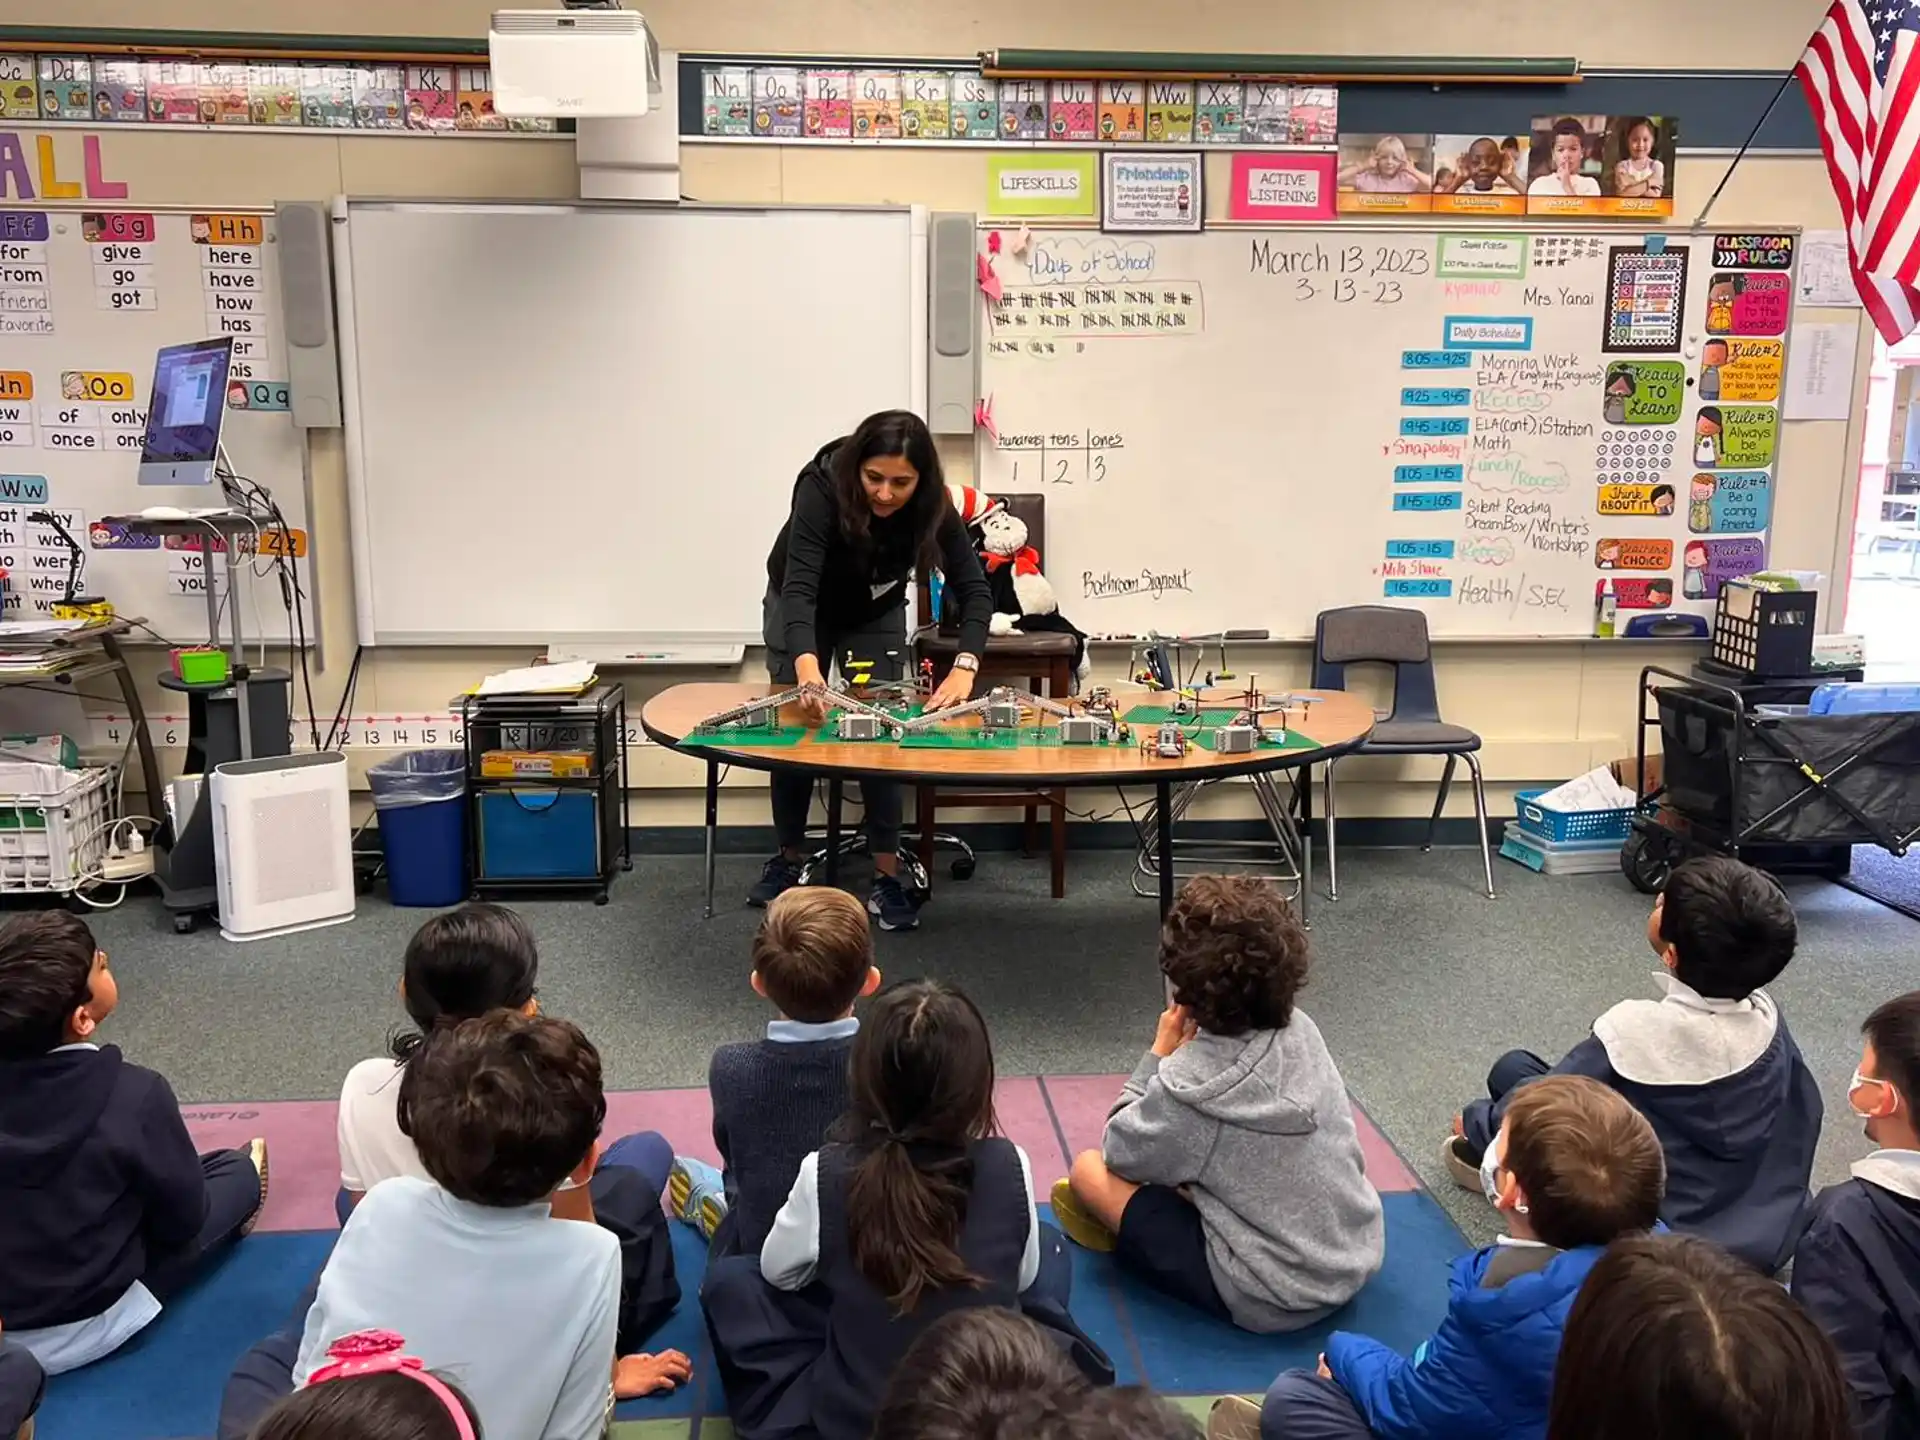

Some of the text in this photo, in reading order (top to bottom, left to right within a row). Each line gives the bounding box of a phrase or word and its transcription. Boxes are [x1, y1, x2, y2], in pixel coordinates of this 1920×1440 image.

[51, 58, 75, 81] Dd
[419, 67, 443, 91] Kk
[711, 75, 740, 98] Nn
[765, 77, 786, 99] Oo
[817, 77, 838, 109] Pp
[863, 78, 890, 109] Qq
[914, 78, 939, 101] Rr
[964, 79, 986, 103] Ss
[1012, 81, 1035, 102] Tt
[1061, 82, 1085, 105] Uu
[1109, 83, 1133, 106] Vv
[1152, 84, 1187, 106] Ww
[1207, 84, 1231, 107] Xx
[1256, 84, 1277, 110] Yy
[1116, 166, 1190, 183] Friendship
[1260, 172, 1307, 187] ACTIVE
[1000, 176, 1078, 191] LIFESKILLS
[1249, 188, 1317, 204] LISTENING
[0, 244, 30, 259] for
[1715, 236, 1792, 250] CLASSROOM
[103, 245, 142, 262] give
[209, 248, 252, 265] here
[1249, 239, 1329, 276] March
[1737, 248, 1788, 264] RULES
[1034, 250, 1155, 281] Days of School
[113, 269, 136, 285] go
[209, 271, 255, 288] have
[111, 291, 141, 308] got
[215, 294, 253, 311] how
[1558, 287, 1595, 307] Yanai
[221, 317, 252, 332] has
[1481, 353, 1580, 373] Morning Work
[1634, 366, 1682, 386] Ready
[1646, 385, 1667, 398] TO
[0, 409, 20, 422] ew
[59, 408, 80, 424] of
[1628, 400, 1678, 416] Learn
[111, 408, 147, 428] only
[51, 432, 96, 448] once
[116, 433, 146, 447] one
[1050, 433, 1080, 446] tens
[1091, 433, 1123, 447] ones
[1728, 427, 1772, 439] Always
[1472, 435, 1511, 451] Math
[1740, 439, 1757, 450] be
[1725, 451, 1768, 463] honest
[1012, 455, 1106, 484] 1 2 3
[1608, 486, 1644, 500] Think
[1728, 492, 1742, 502] Be
[1466, 497, 1550, 516] Silent Reading
[1600, 500, 1651, 511] ABOUT IT
[1722, 505, 1758, 518] caring
[1720, 518, 1756, 530] friend
[1532, 532, 1590, 558] Workshop
[1622, 555, 1664, 566] CHOICE
[1716, 559, 1756, 570] Always
[30, 575, 85, 592] whee
[1082, 568, 1193, 600] Bathroom Signout
[107, 729, 120, 743] 4
[165, 729, 177, 744] 6
[335, 731, 351, 745] 12
[364, 730, 381, 744] 13
[392, 729, 409, 744] 14
[421, 728, 437, 743] 15
[449, 728, 465, 743] 16
[533, 728, 548, 742] 19
[559, 727, 579, 742] 20
